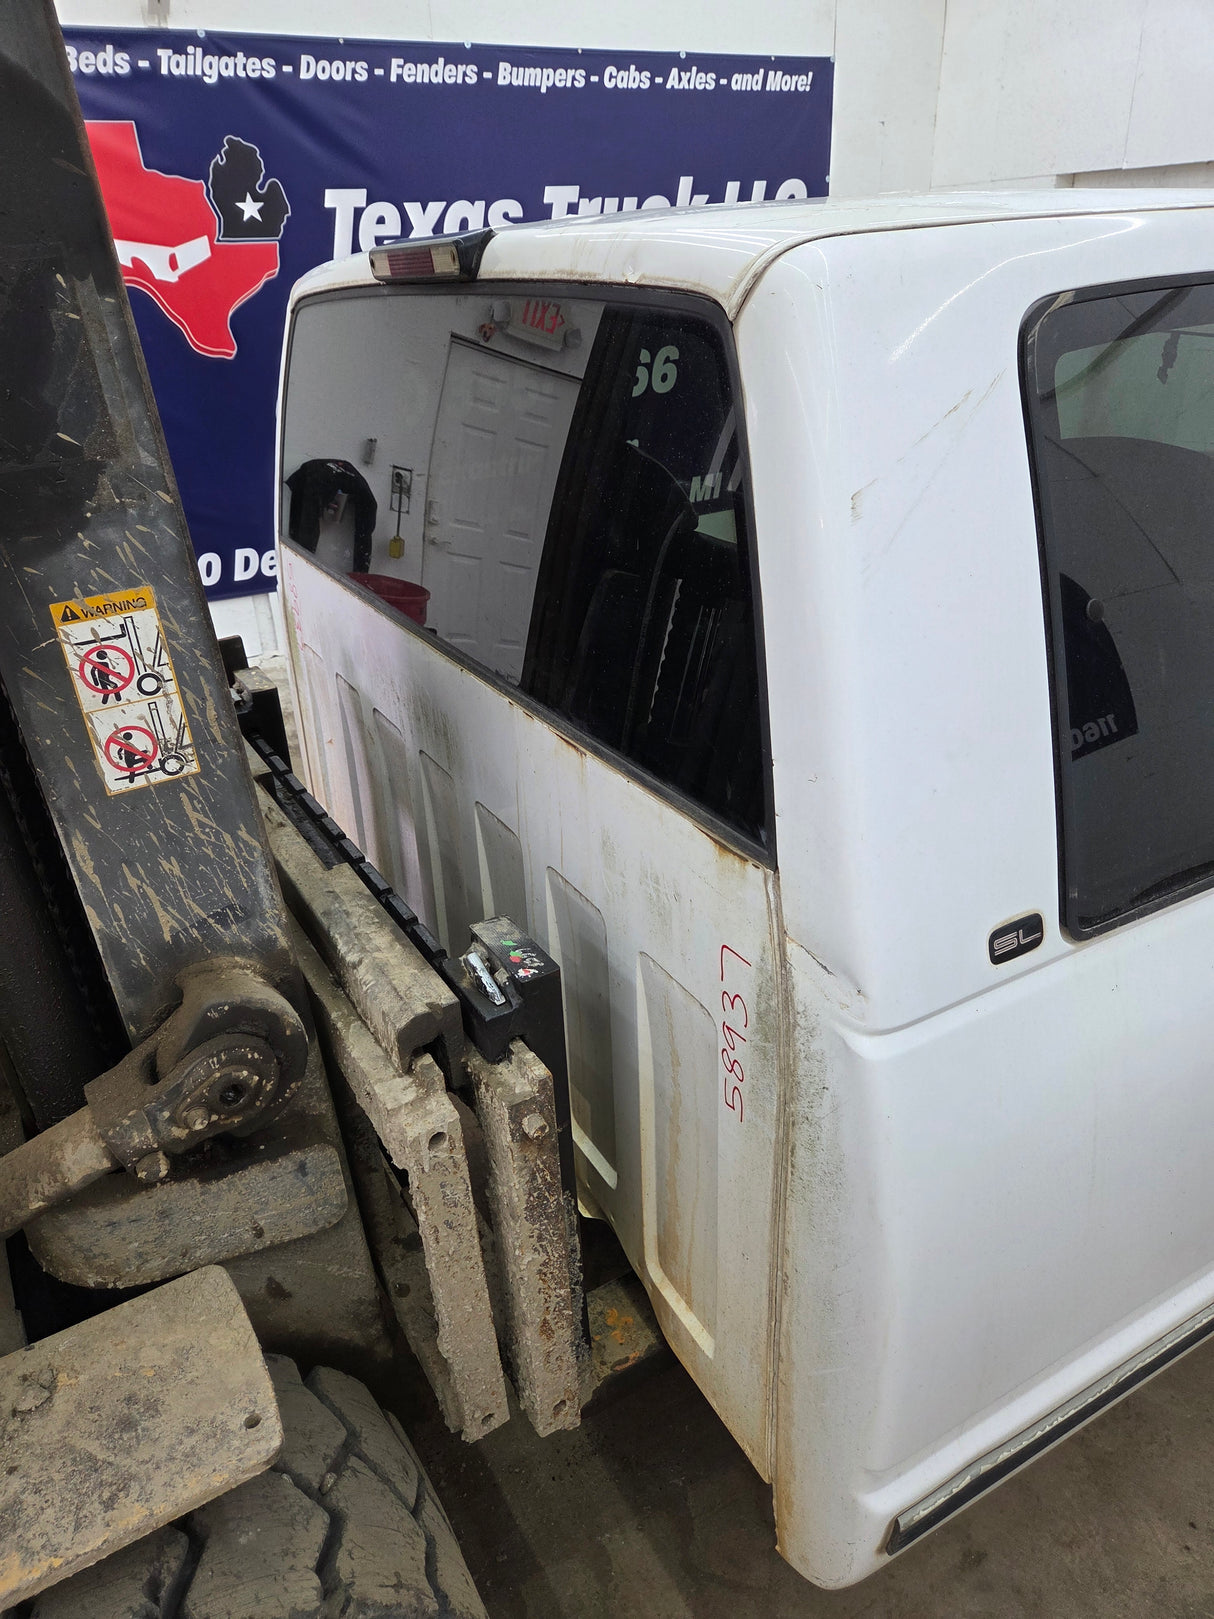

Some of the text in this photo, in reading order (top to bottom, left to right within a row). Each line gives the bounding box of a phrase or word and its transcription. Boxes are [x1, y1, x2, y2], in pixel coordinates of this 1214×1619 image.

[157, 45, 276, 84] Tailgates
[299, 54, 369, 82] Doors
[390, 57, 478, 85] Fenders
[497, 61, 586, 94] Bumpers
[603, 64, 651, 90] Cabs
[665, 66, 717, 91] Axles
[731, 68, 764, 92] and
[765, 70, 813, 92] More!
[80, 597, 147, 619] WARNING
[993, 929, 1042, 956] SL
[720, 944, 752, 1123] 58937
